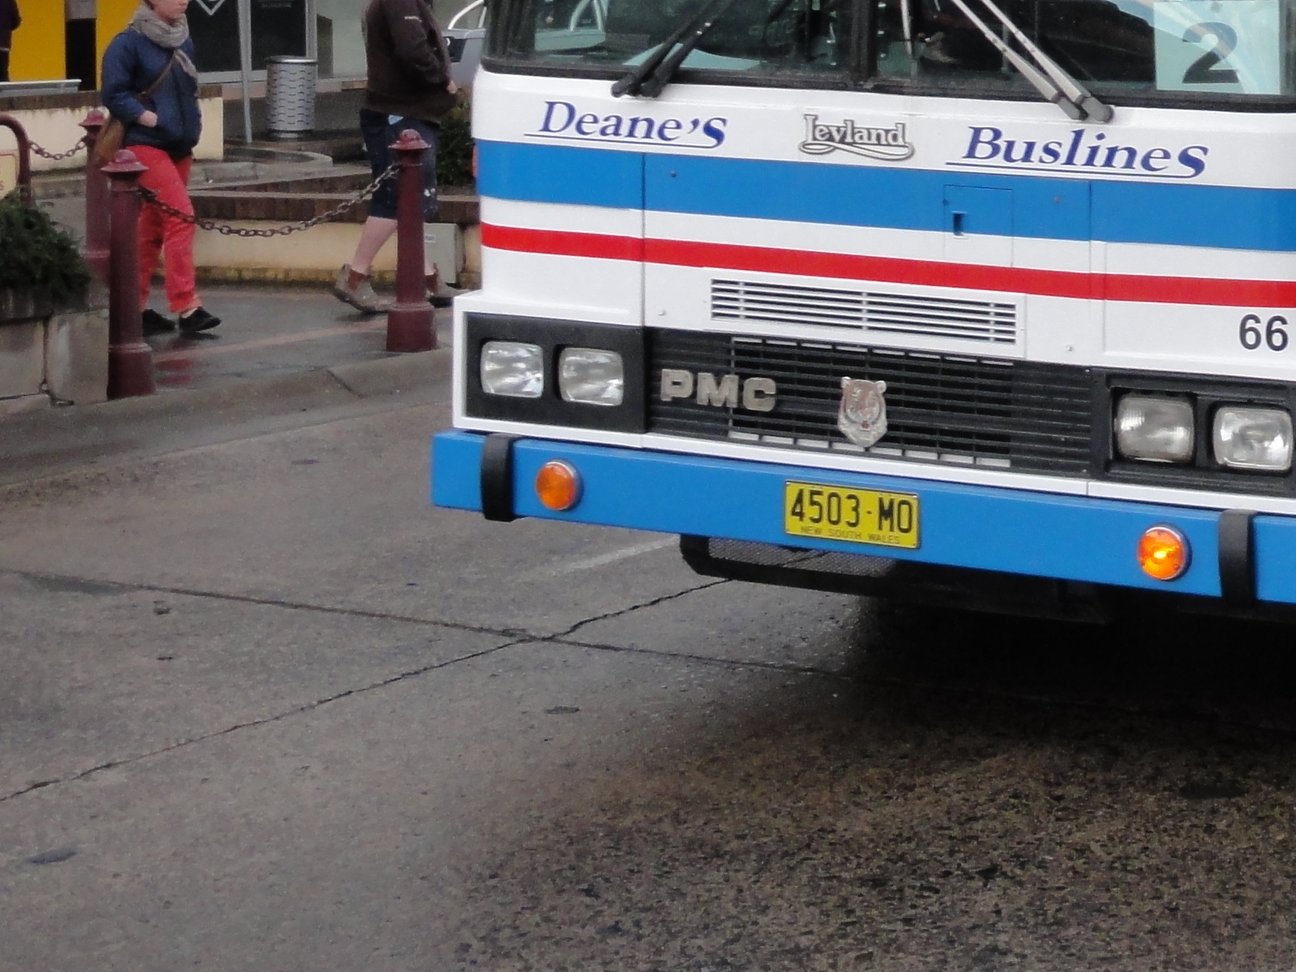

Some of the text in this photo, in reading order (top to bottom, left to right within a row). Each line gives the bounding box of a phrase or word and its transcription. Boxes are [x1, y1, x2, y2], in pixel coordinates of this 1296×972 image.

[1181, 22, 1239, 84] 2
[798, 113, 915, 161] Leyland
[1239, 314, 1289, 351] 66
[661, 368, 777, 412] PMC
[801, 526, 900, 544] NEW SOUTH WALES
